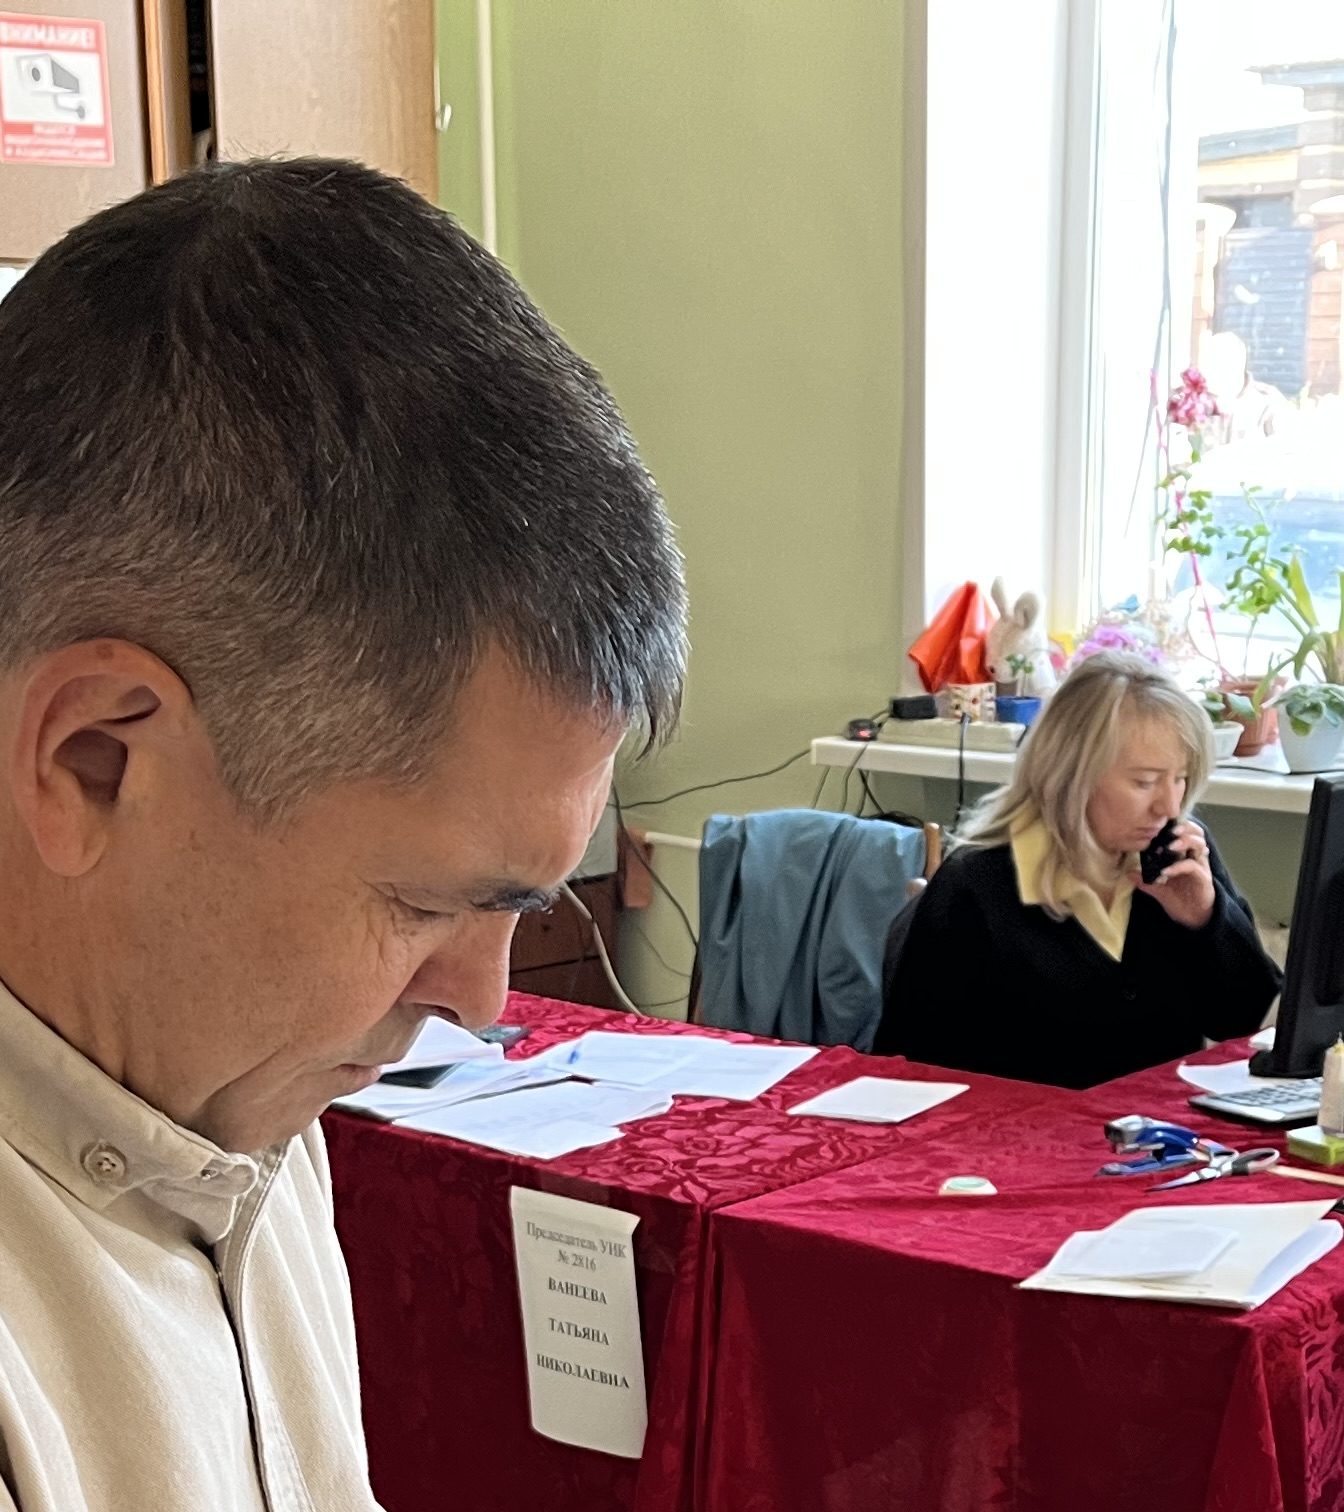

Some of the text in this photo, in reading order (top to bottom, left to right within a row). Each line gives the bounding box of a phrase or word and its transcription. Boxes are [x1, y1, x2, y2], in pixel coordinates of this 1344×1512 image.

[526, 1221, 627, 1259] Председатель УИК
[548, 1277, 607, 1305] ВАНЕЕВА
[548, 1318, 610, 1346] ТАТЬЯНА
[536, 1353, 630, 1389] НИКОЛАЕВНА
